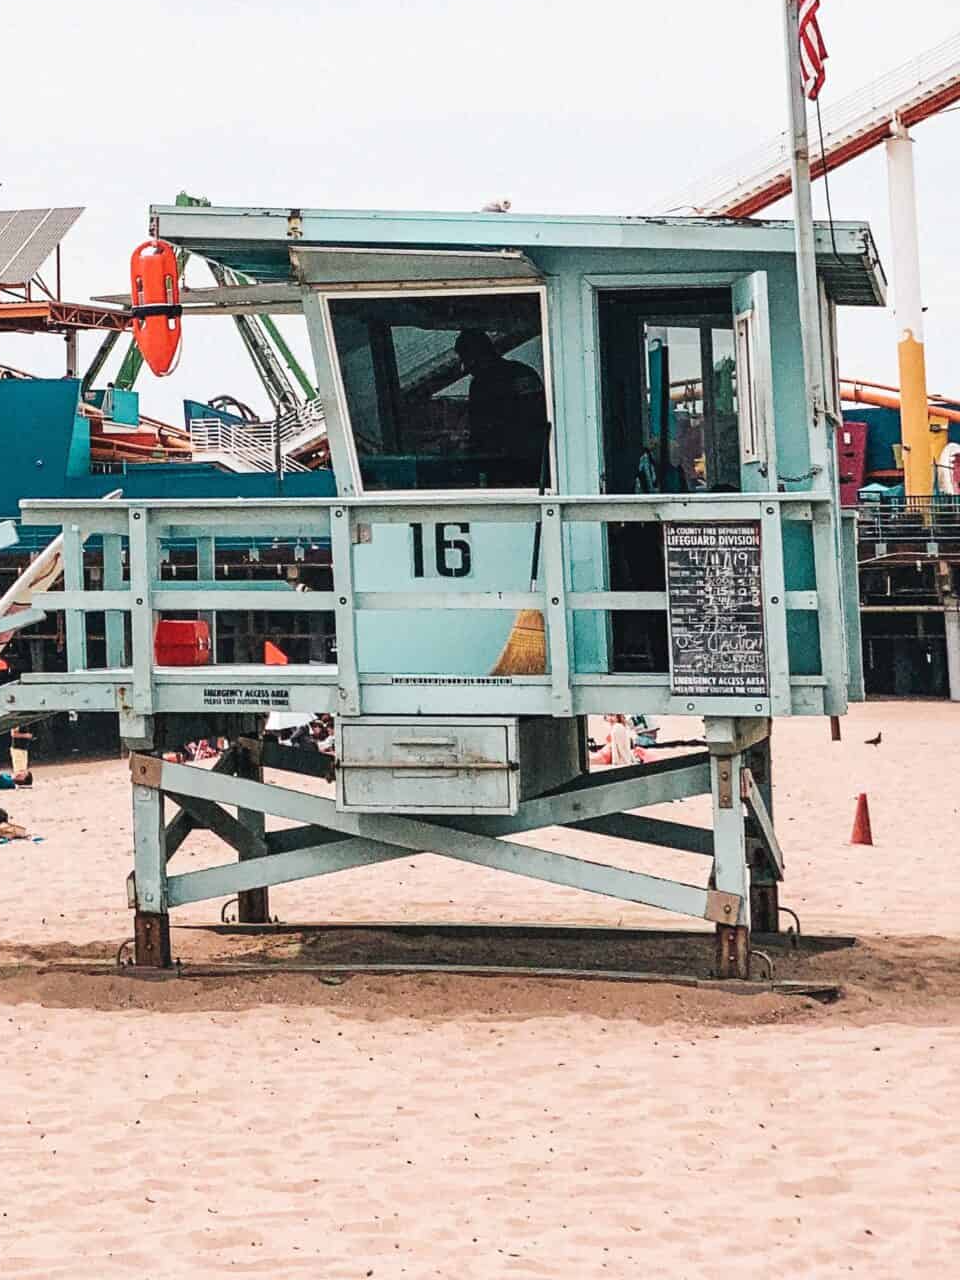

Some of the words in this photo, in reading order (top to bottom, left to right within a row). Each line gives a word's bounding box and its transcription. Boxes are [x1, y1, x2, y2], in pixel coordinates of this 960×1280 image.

[676, 527, 701, 535] COUNTY
[667, 535, 717, 546] LIFEGUARD
[718, 535, 760, 546] DIVISION
[409, 522, 471, 578] 16
[674, 676, 717, 685] EMERGENCY
[719, 676, 744, 685] ACCESS
[746, 676, 765, 685] AREA
[204, 689, 242, 697] EMERGENCY
[244, 689, 269, 697] ACCESS
